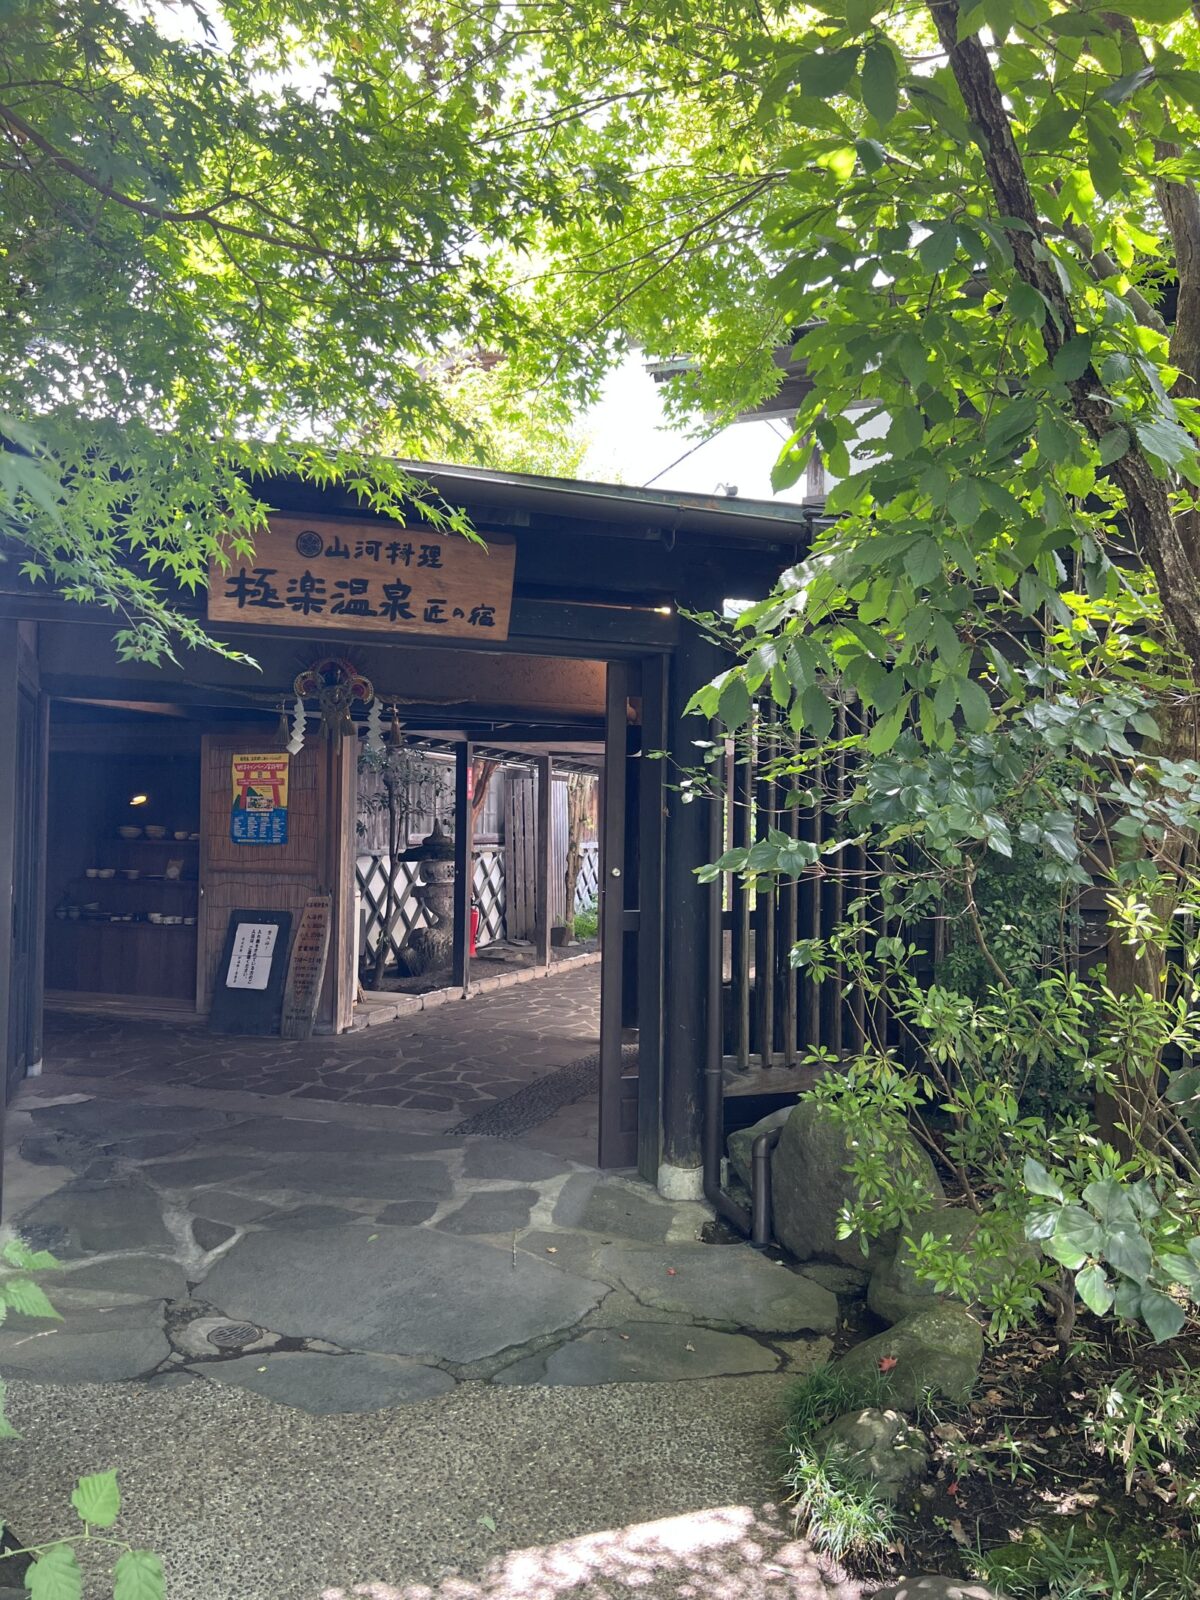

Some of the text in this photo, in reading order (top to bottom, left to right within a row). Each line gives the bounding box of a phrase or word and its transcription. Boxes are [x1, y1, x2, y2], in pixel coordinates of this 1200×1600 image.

[324, 535, 444, 569] 山河料理
[224, 567, 497, 627] 極楽温泉 匠の宿
